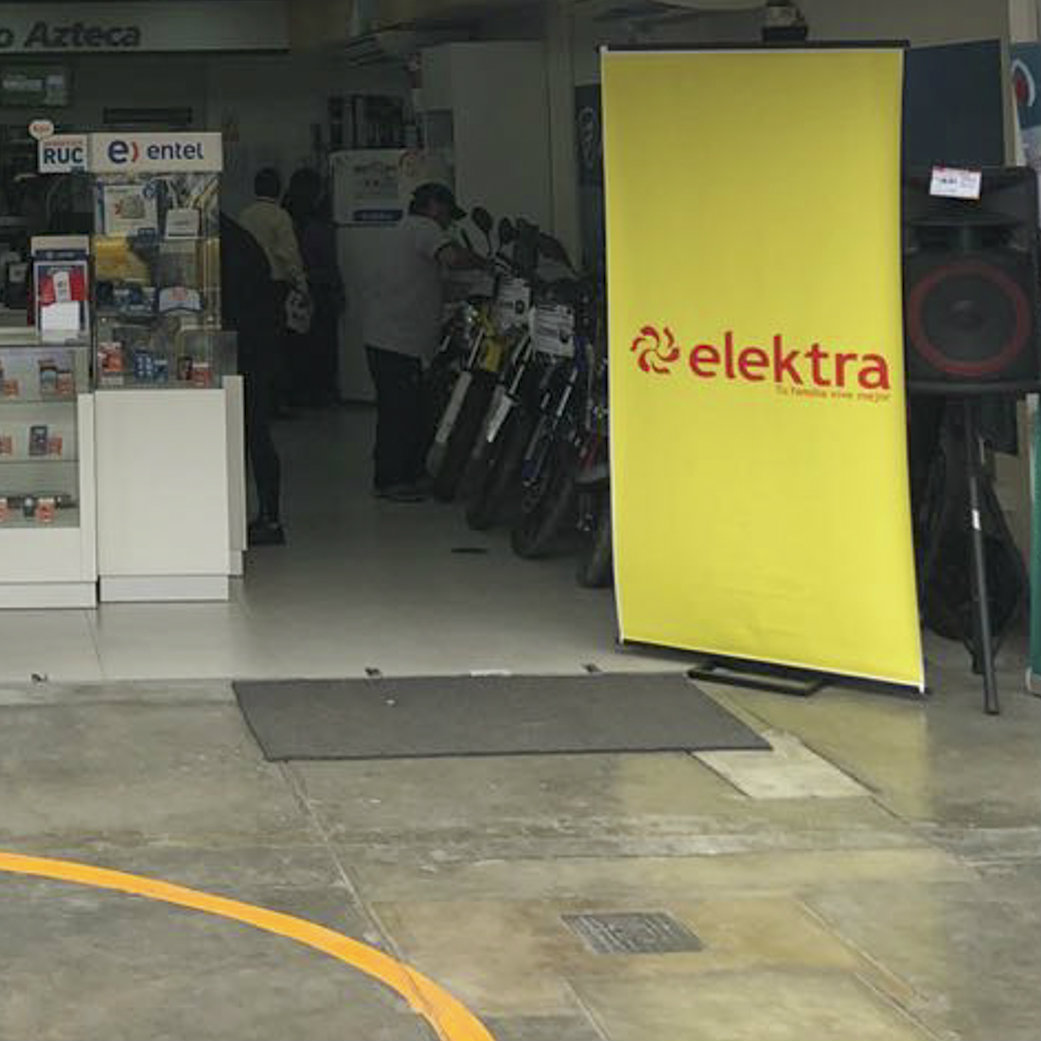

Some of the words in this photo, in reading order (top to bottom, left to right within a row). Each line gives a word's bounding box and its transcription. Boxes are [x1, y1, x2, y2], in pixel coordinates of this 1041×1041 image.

[24, 21, 142, 48] Azteca
[43, 147, 83, 165] RUC
[147, 141, 204, 160] entel
[689, 331, 890, 390] elektra
